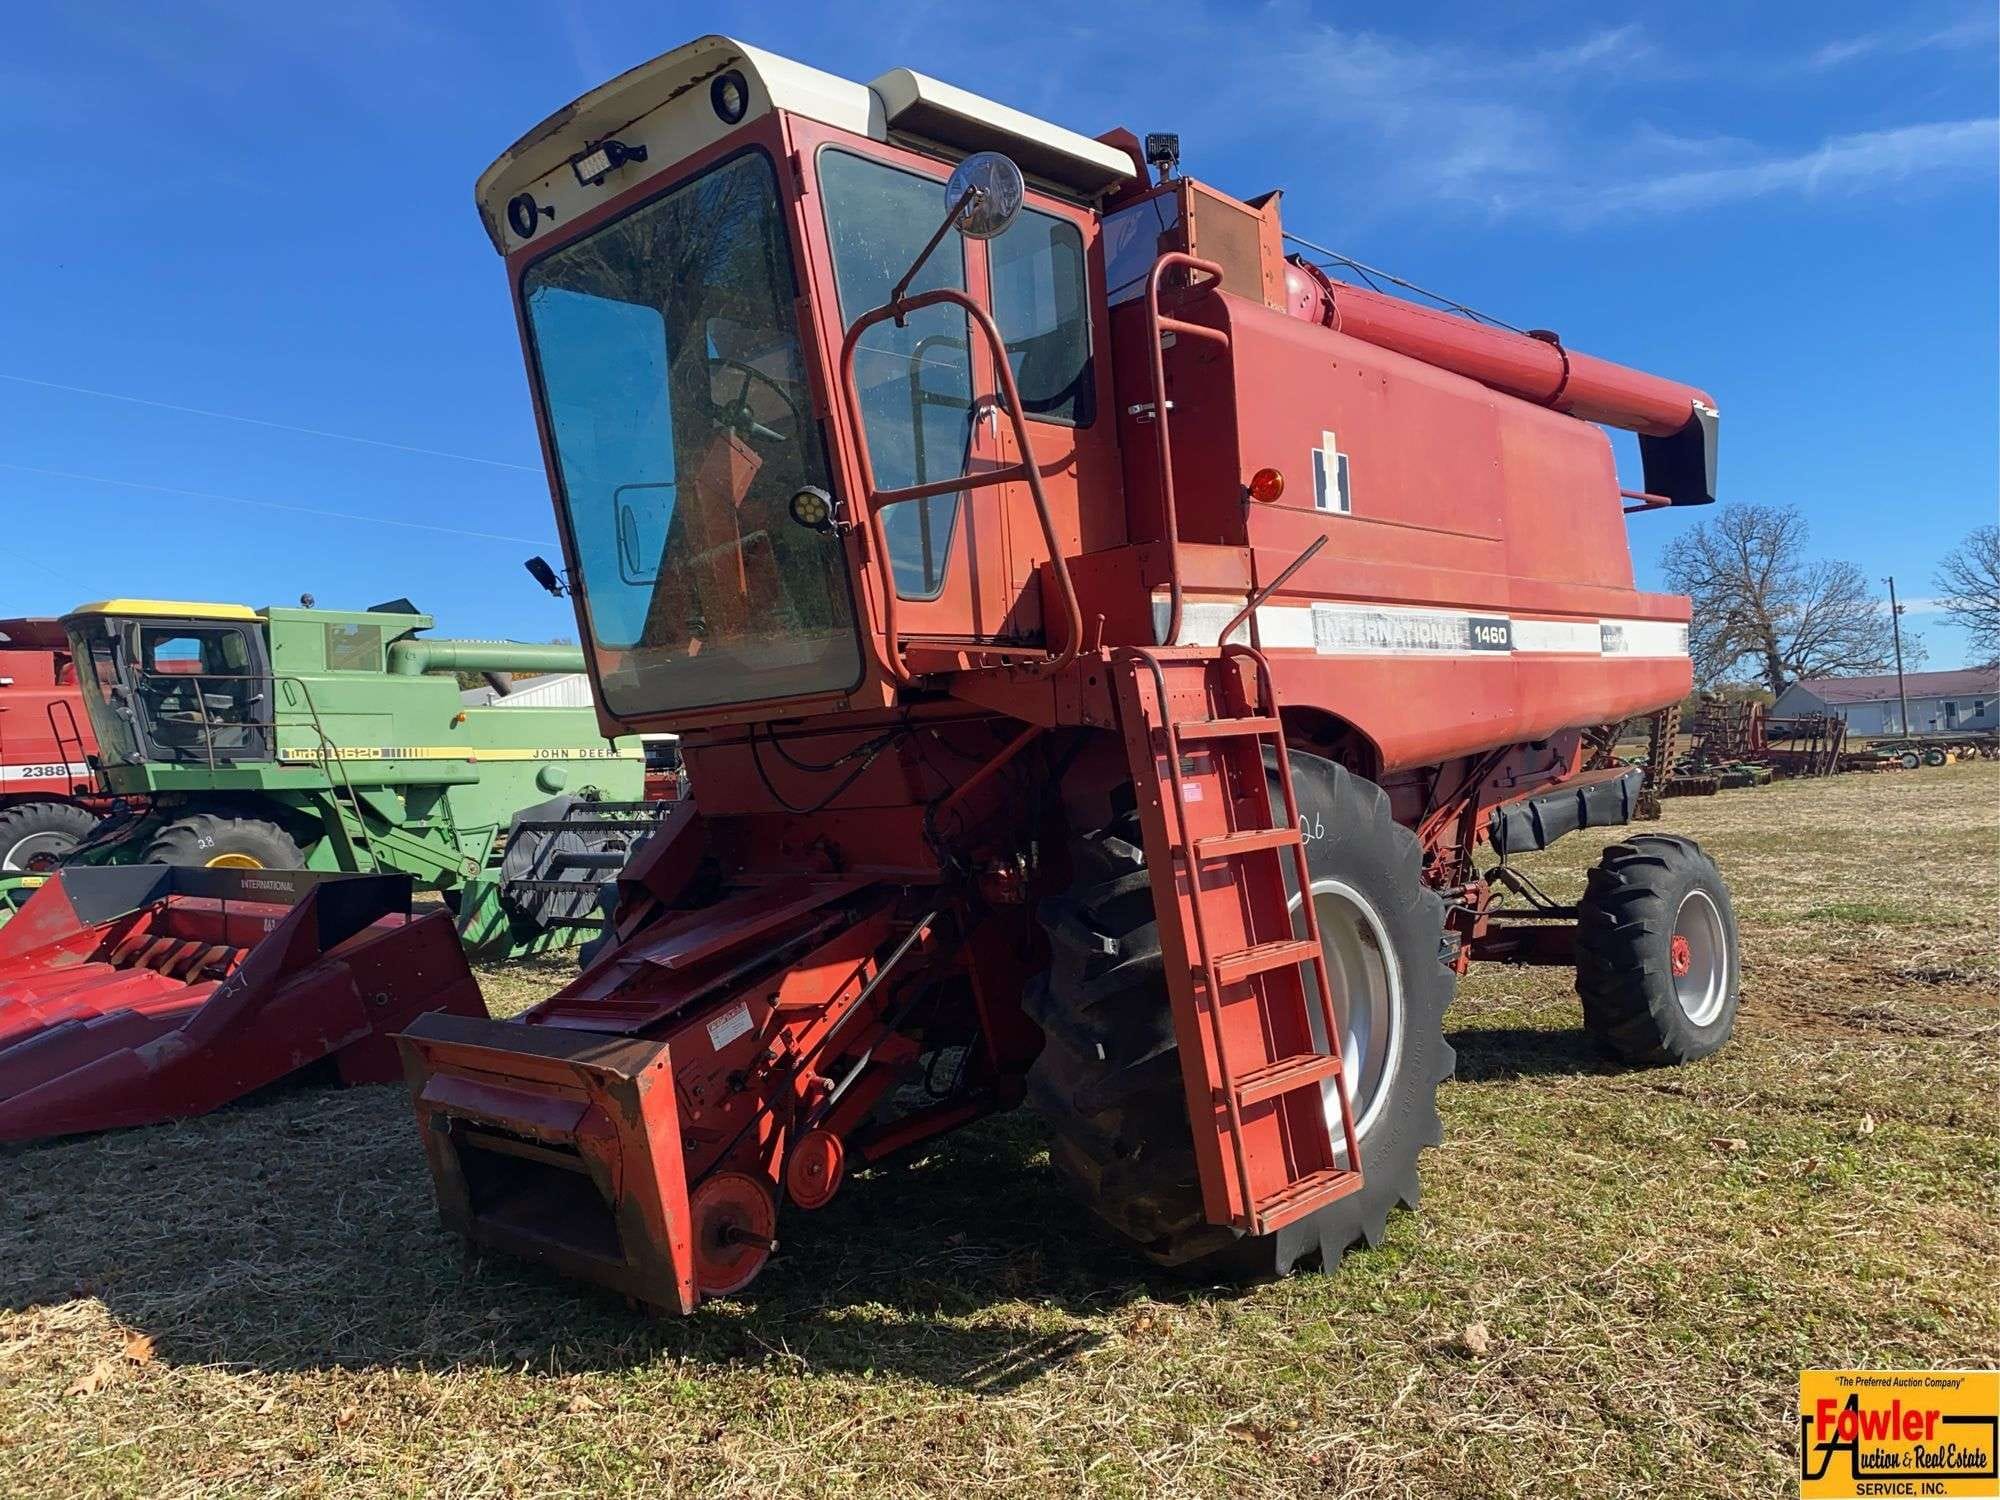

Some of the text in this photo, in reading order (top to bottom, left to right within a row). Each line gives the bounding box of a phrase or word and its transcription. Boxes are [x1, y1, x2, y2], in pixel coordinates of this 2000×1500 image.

[1318, 614, 1507, 645] INTERNATIONAL 1460
[533, 749, 622, 758] JOHN DEERE
[22, 766, 66, 778] 2388
[1300, 811, 1325, 845] 26
[197, 835, 215, 849] 28
[241, 879, 295, 892] INTERNATIONAL
